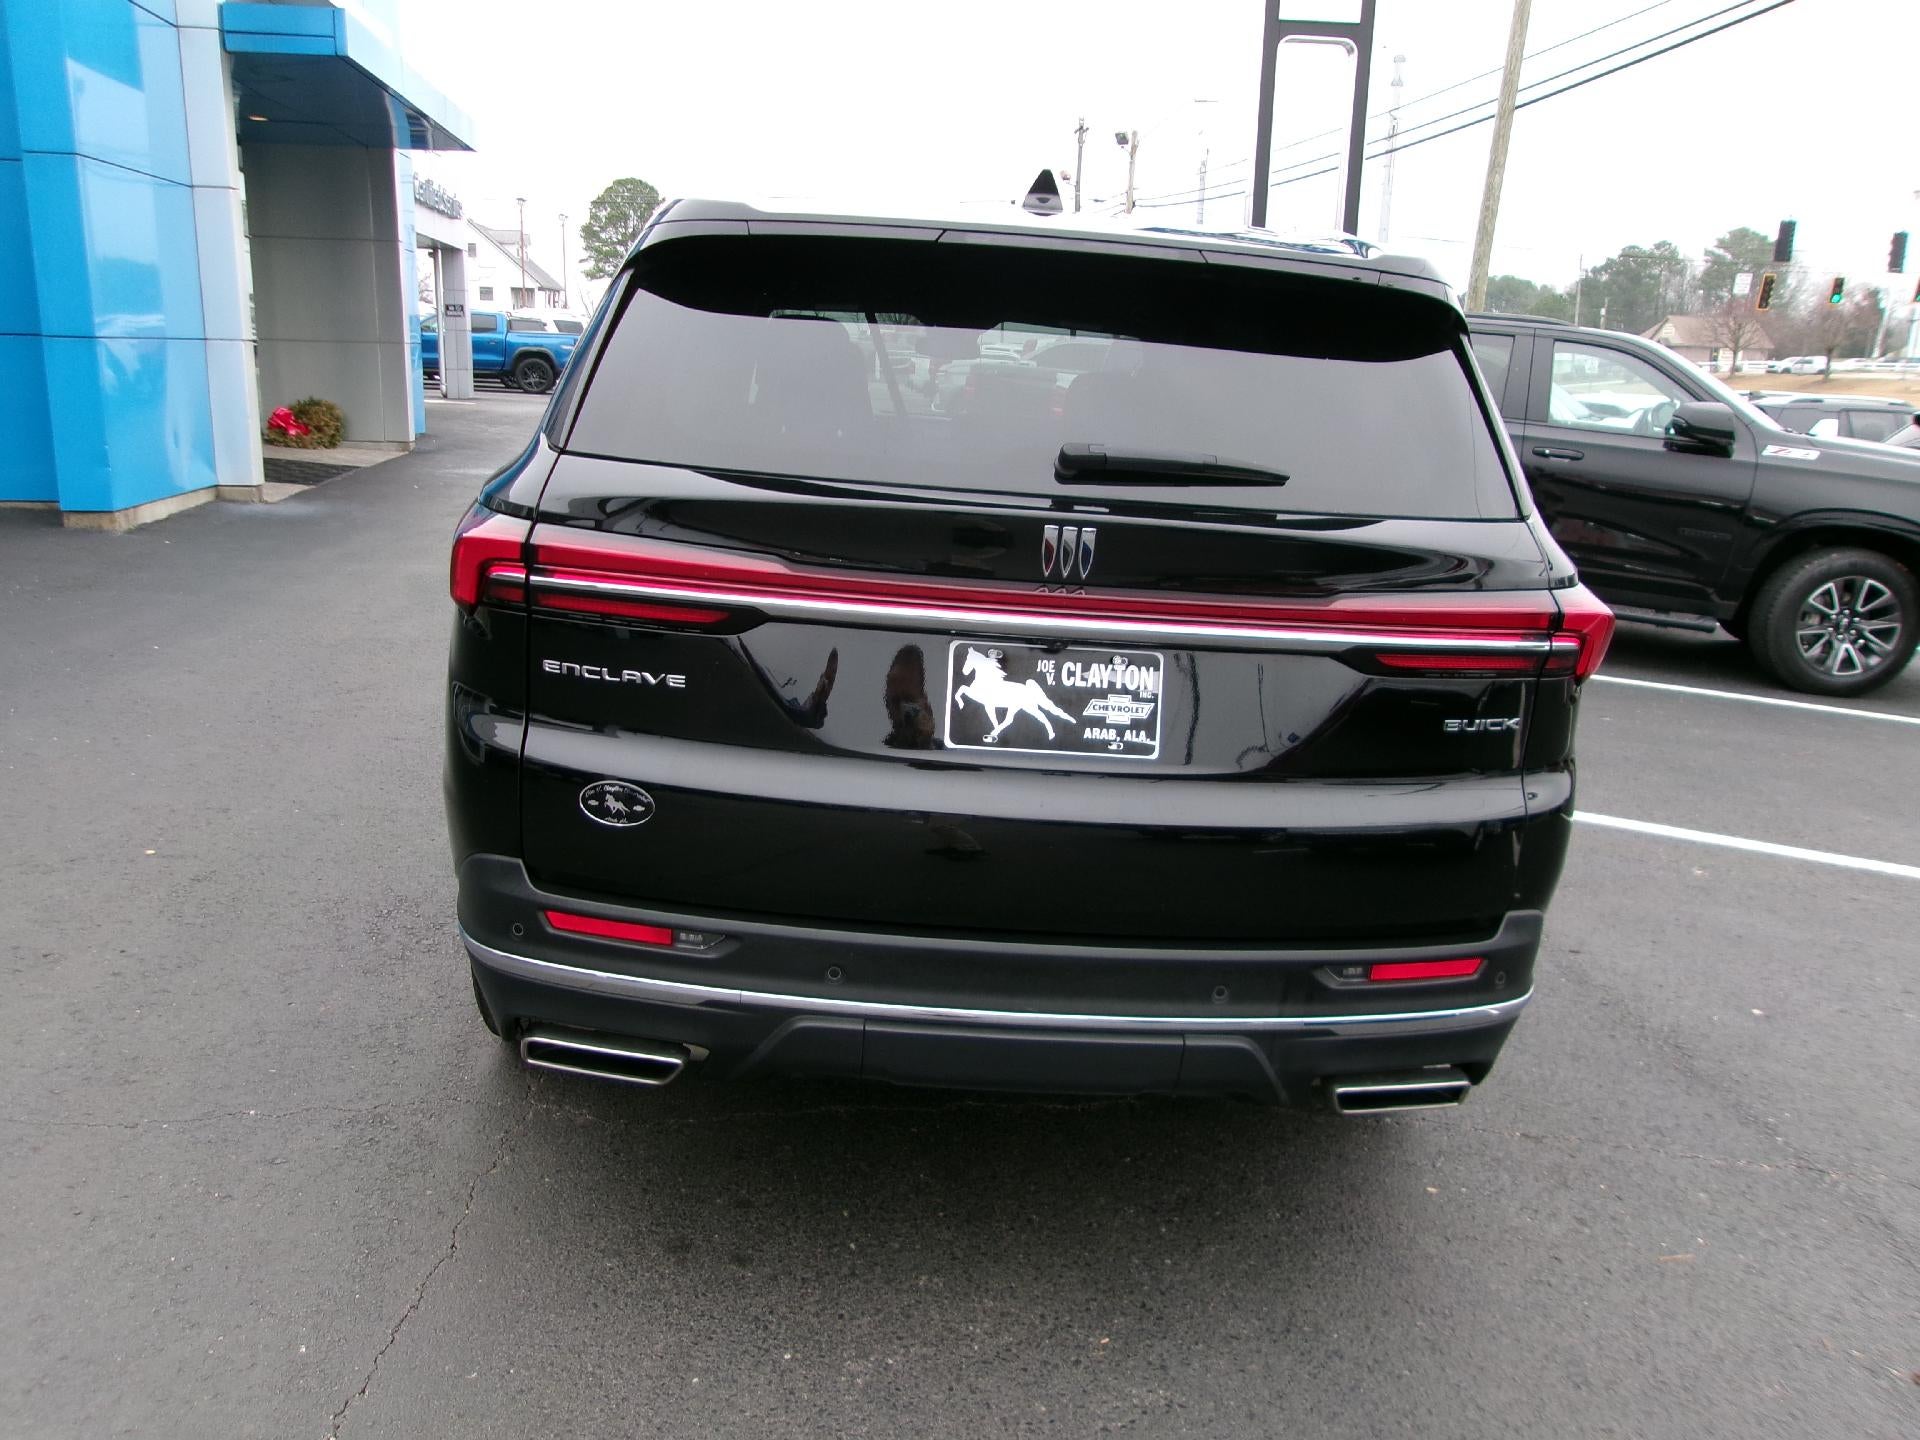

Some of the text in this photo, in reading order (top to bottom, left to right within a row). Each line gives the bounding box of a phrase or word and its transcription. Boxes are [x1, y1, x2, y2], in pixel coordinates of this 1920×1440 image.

[1037, 659, 1056, 673] JOE
[542, 659, 686, 688] ENCLAVE
[1046, 672, 1056, 686] V.
[1061, 661, 1154, 691] CLAYTON
[1092, 703, 1145, 715] CHEVROLET
[1443, 717, 1520, 731] BUICK
[1083, 727, 1150, 742] ARAB, ALA.
